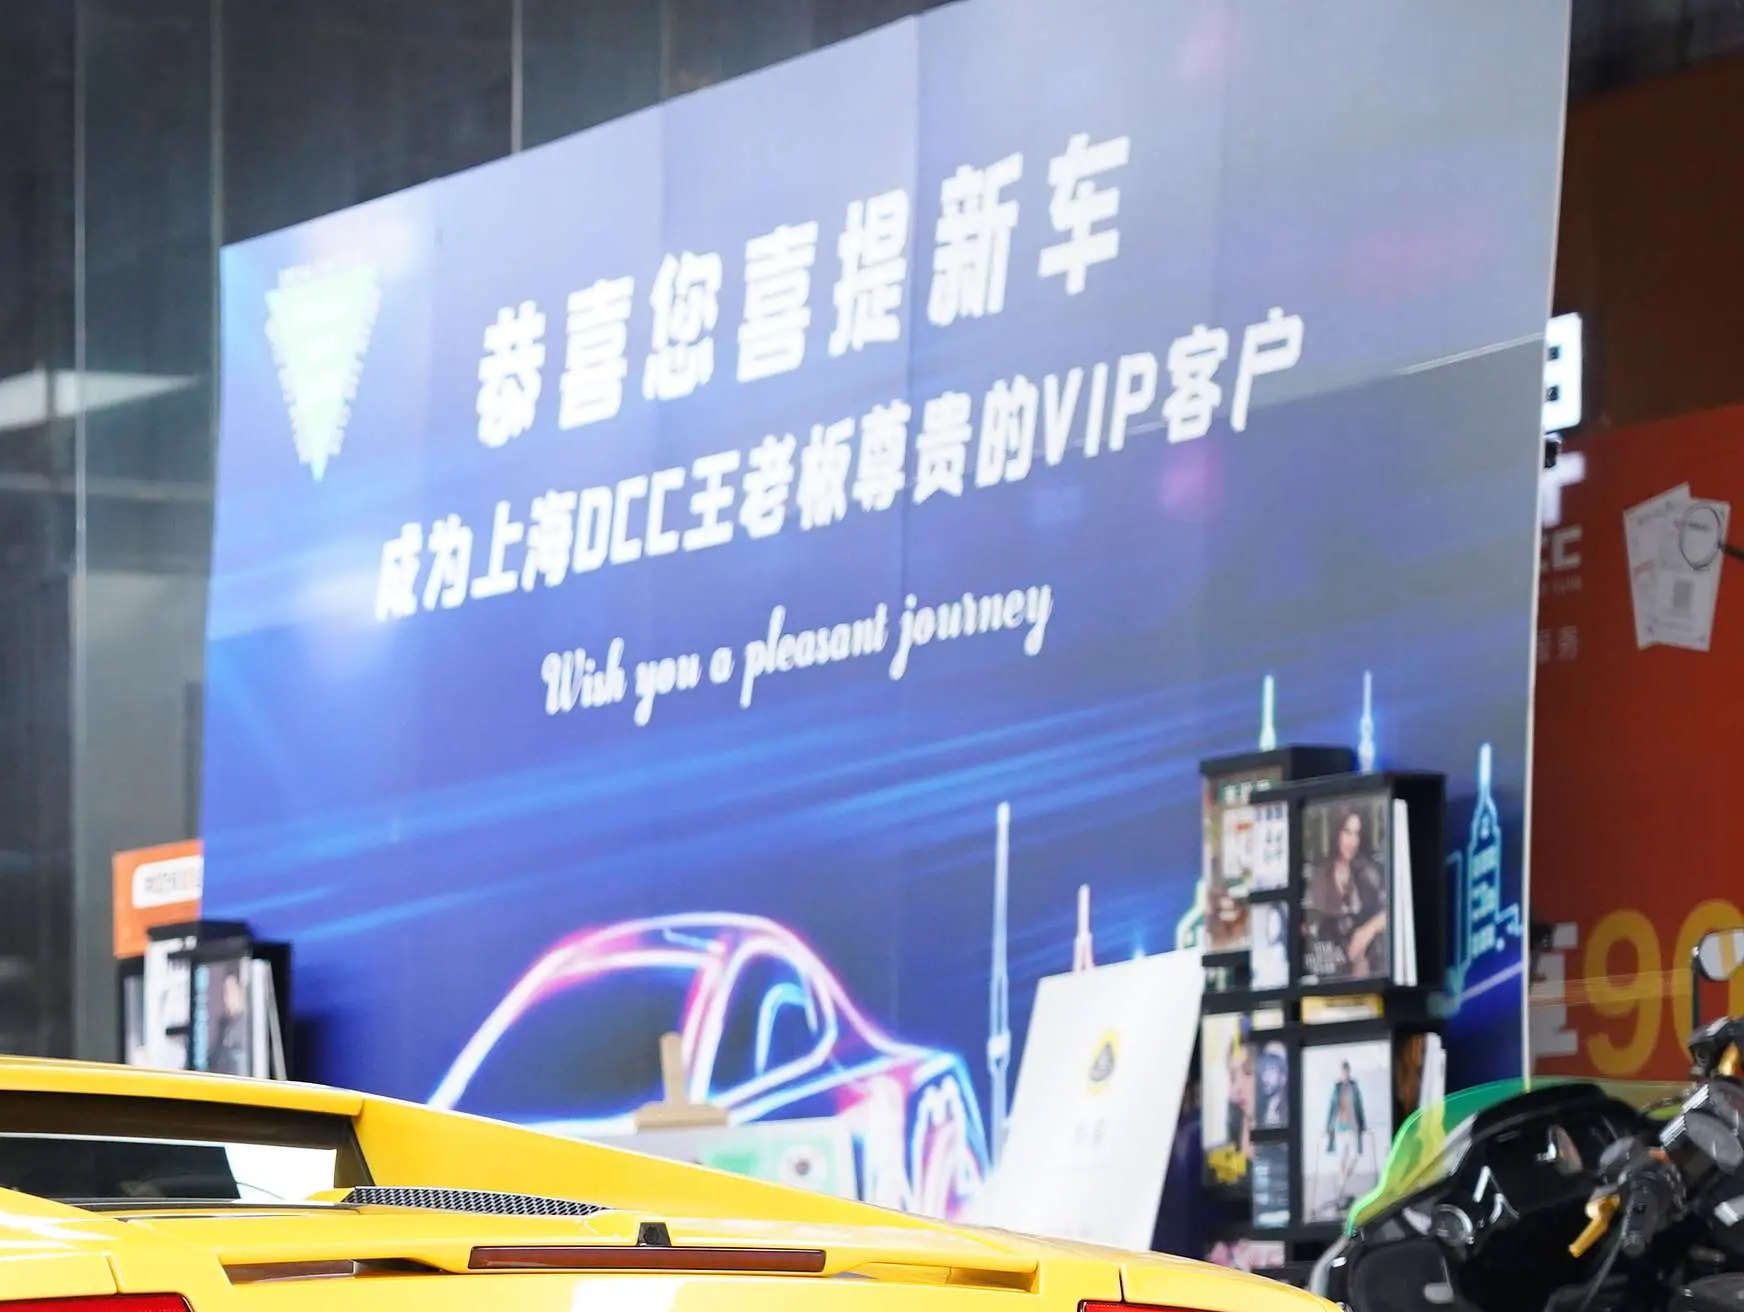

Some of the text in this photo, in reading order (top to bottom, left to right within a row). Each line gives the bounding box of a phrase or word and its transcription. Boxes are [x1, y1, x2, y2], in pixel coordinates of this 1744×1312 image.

[476, 134, 1131, 448] 恭喜您喜提新车
[374, 306, 1304, 623] 成为上海DCC王老板尊贵的VIP客户
[541, 585, 1053, 726] Wish you a pleasant journey
